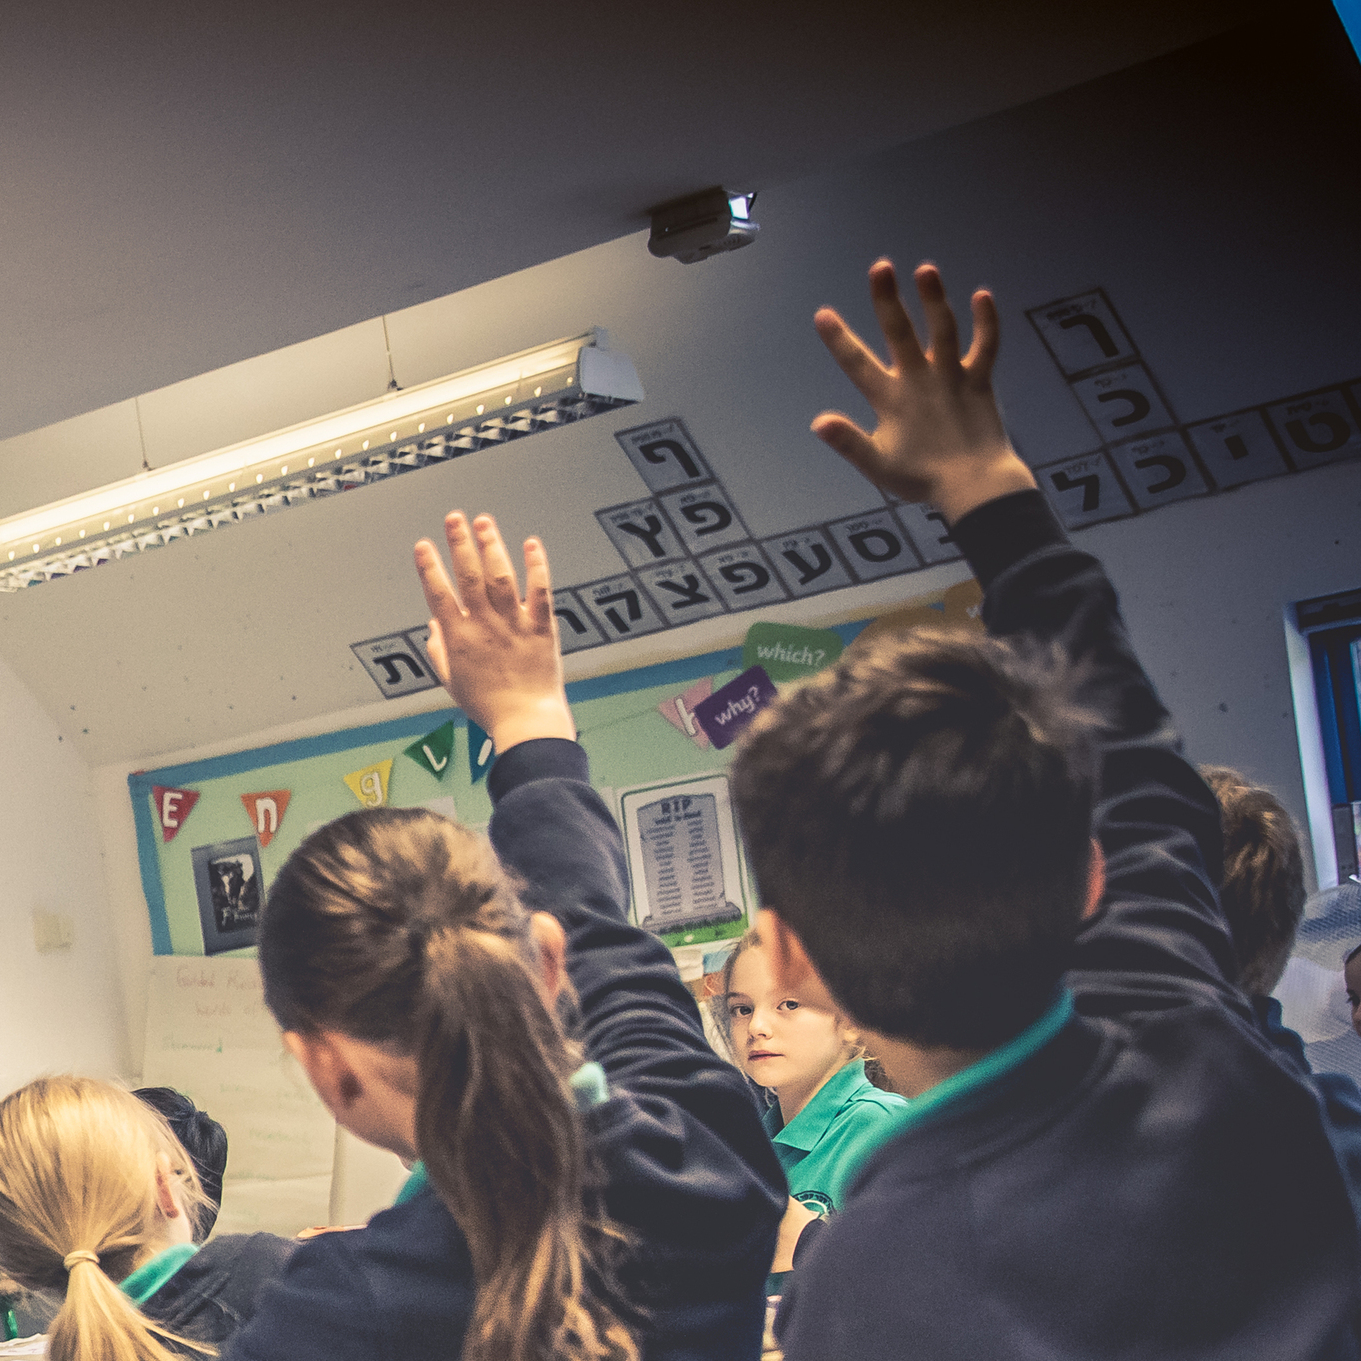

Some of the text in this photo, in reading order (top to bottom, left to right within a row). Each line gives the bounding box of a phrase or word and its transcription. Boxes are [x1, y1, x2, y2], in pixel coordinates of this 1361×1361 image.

[1285, 411, 1352, 452] ט
[638, 439, 701, 479] ף
[1050, 471, 1099, 512] ל
[617, 501, 733, 558] ץ פ
[848, 528, 903, 563] ס
[718, 561, 771, 594] פ
[782, 543, 833, 586] ע
[657, 574, 711, 610] צ
[594, 590, 642, 635] ק
[374, 652, 425, 685] ת
[756, 641, 826, 668] which?
[714, 686, 760, 727] why?
